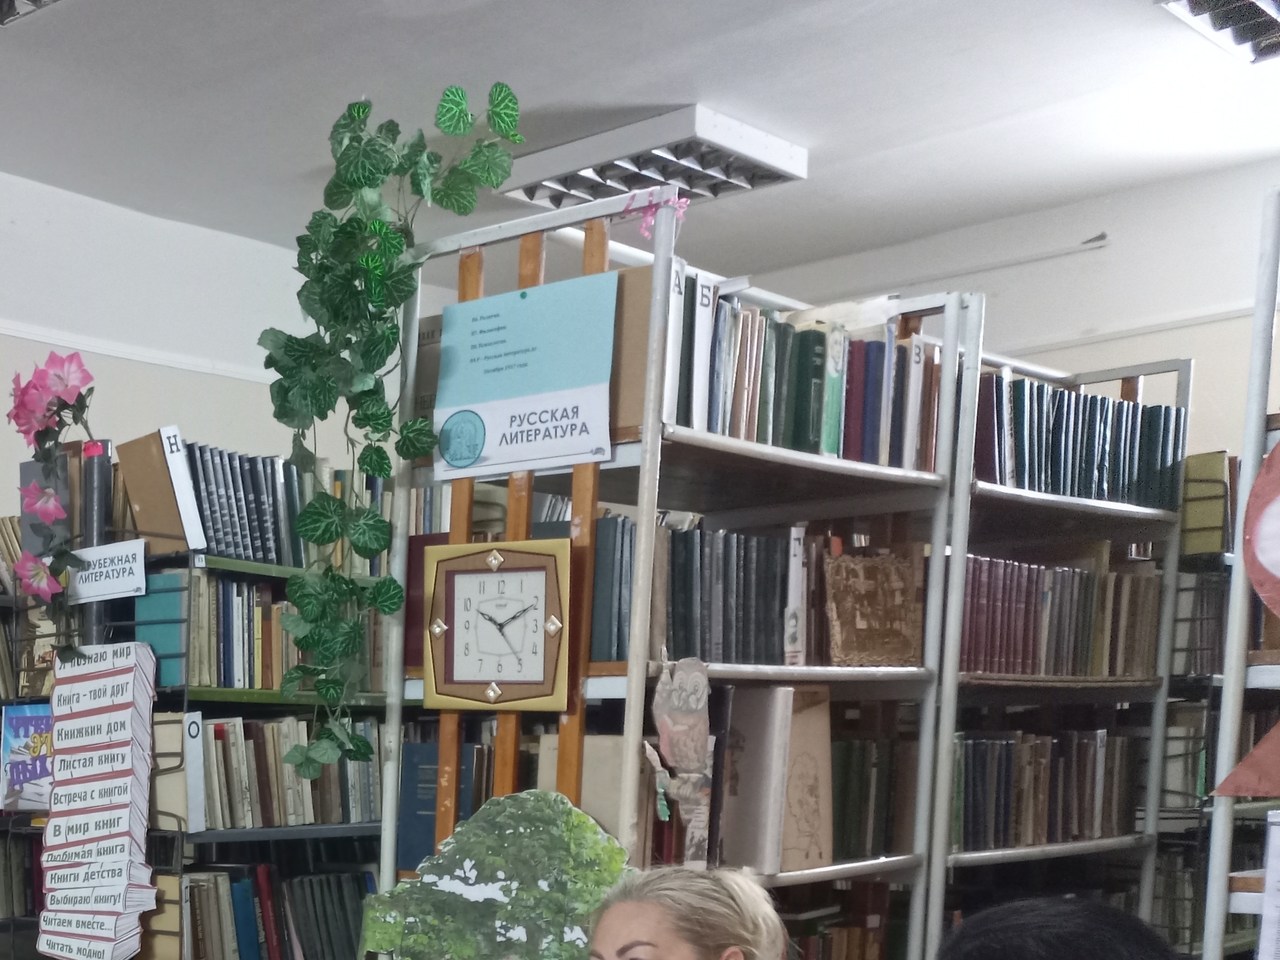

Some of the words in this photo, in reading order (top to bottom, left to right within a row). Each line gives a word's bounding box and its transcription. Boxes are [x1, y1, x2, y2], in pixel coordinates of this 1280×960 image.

[672, 270, 683, 295] А
[699, 284, 711, 307] Б
[509, 405, 580, 428] РУССКАЯ
[498, 422, 590, 446] ЛИТЕРАТУРА
[166, 434, 181, 454] Н
[78, 565, 135, 585] ЛИТЕРАТУРА
[479, 581, 486, 595] 11
[498, 580, 505, 594] 12
[520, 579, 523, 593] 1
[463, 597, 472, 612] 10
[533, 595, 539, 610] 2
[464, 620, 470, 634] 9
[532, 619, 538, 633] 3
[112, 646, 131, 660] мир
[464, 642, 470, 657] 8
[531, 641, 538, 656] 4
[477, 658, 483, 673] 7
[497, 660, 503, 673] 6
[517, 658, 523, 673] 5
[57, 692, 80, 708] Книга
[89, 684, 107, 701] твой
[110, 681, 130, 698] друг
[57, 724, 102, 742] Книжкин
[106, 720, 126, 736] дом
[58, 756, 94, 772] Листая
[98, 752, 126, 766] книгу
[53, 790, 87, 806] Встреча
[90, 789, 95, 800] с
[98, 782, 128, 799] книгой
[53, 824, 61, 837] В
[67, 822, 90, 836] мир
[94, 816, 123, 831] книг
[46, 848, 93, 863] Любимая
[96, 843, 125, 858] книга
[50, 872, 80, 885] Книги
[82, 867, 123, 883] детства
[49, 894, 91, 907] Выбираю
[93, 892, 122, 906] книгу!
[42, 915, 73, 928] Читаем
[75, 919, 113, 931] вместе...
[46, 938, 74, 953] Читать
[76, 946, 106, 960] модно!
